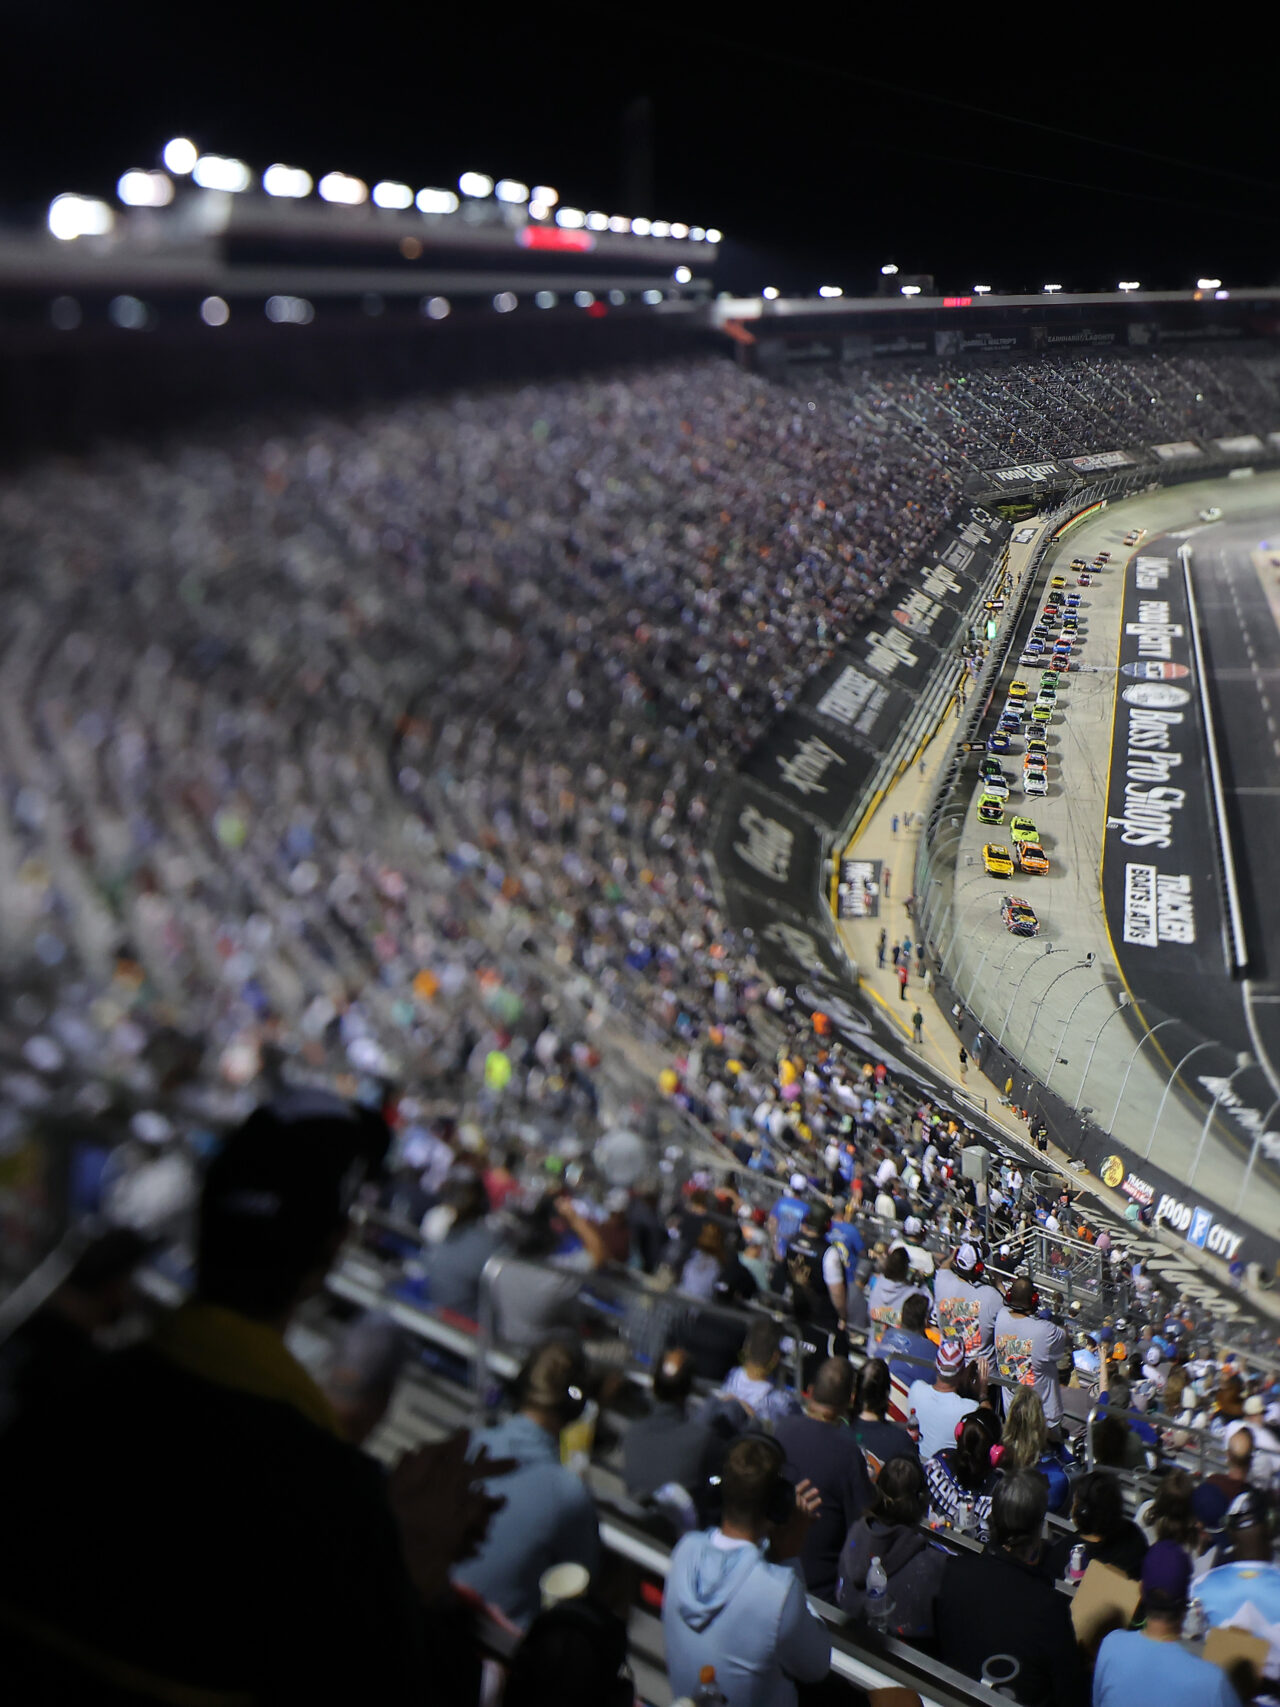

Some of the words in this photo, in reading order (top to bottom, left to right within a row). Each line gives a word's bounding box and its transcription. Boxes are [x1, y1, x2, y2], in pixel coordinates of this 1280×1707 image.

[996, 470, 1025, 482] FOOD
[1037, 464, 1060, 476] CITY
[1129, 708, 1184, 749] Bass
[1126, 749, 1183, 782] Pro
[1108, 783, 1186, 849] Shops
[1130, 868, 1151, 904] BOATS
[1157, 874, 1195, 945] TRACKER
[1154, 1194, 1192, 1232] FOOD
[1206, 1223, 1244, 1260] CITY
